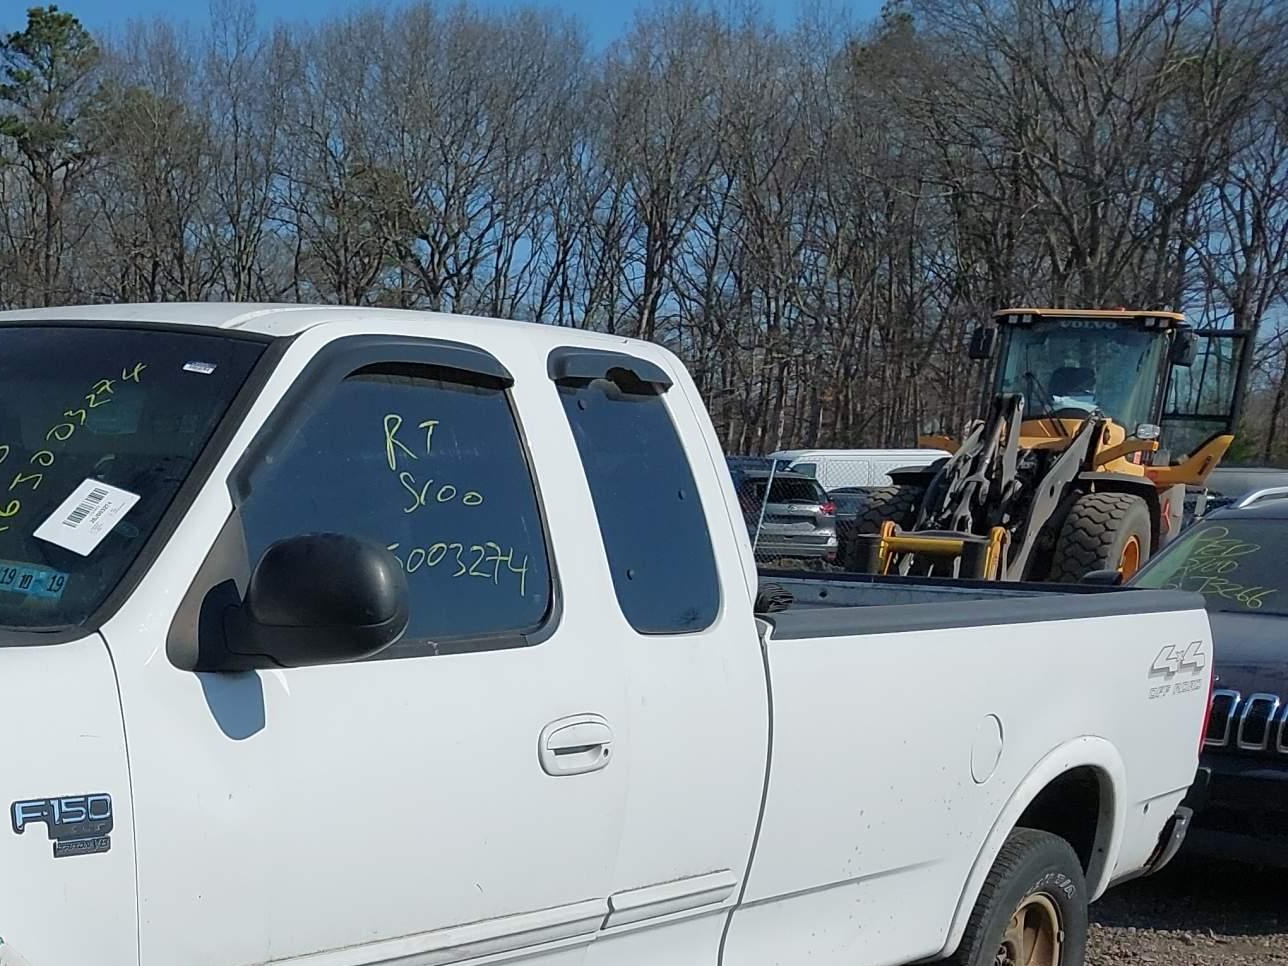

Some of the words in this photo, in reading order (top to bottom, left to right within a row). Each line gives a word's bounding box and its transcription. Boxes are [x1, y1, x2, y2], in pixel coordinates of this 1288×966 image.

[1061, 320, 1117, 328] VOLVO
[384, 414, 439, 470] RT
[46, 575, 65, 592] 19
